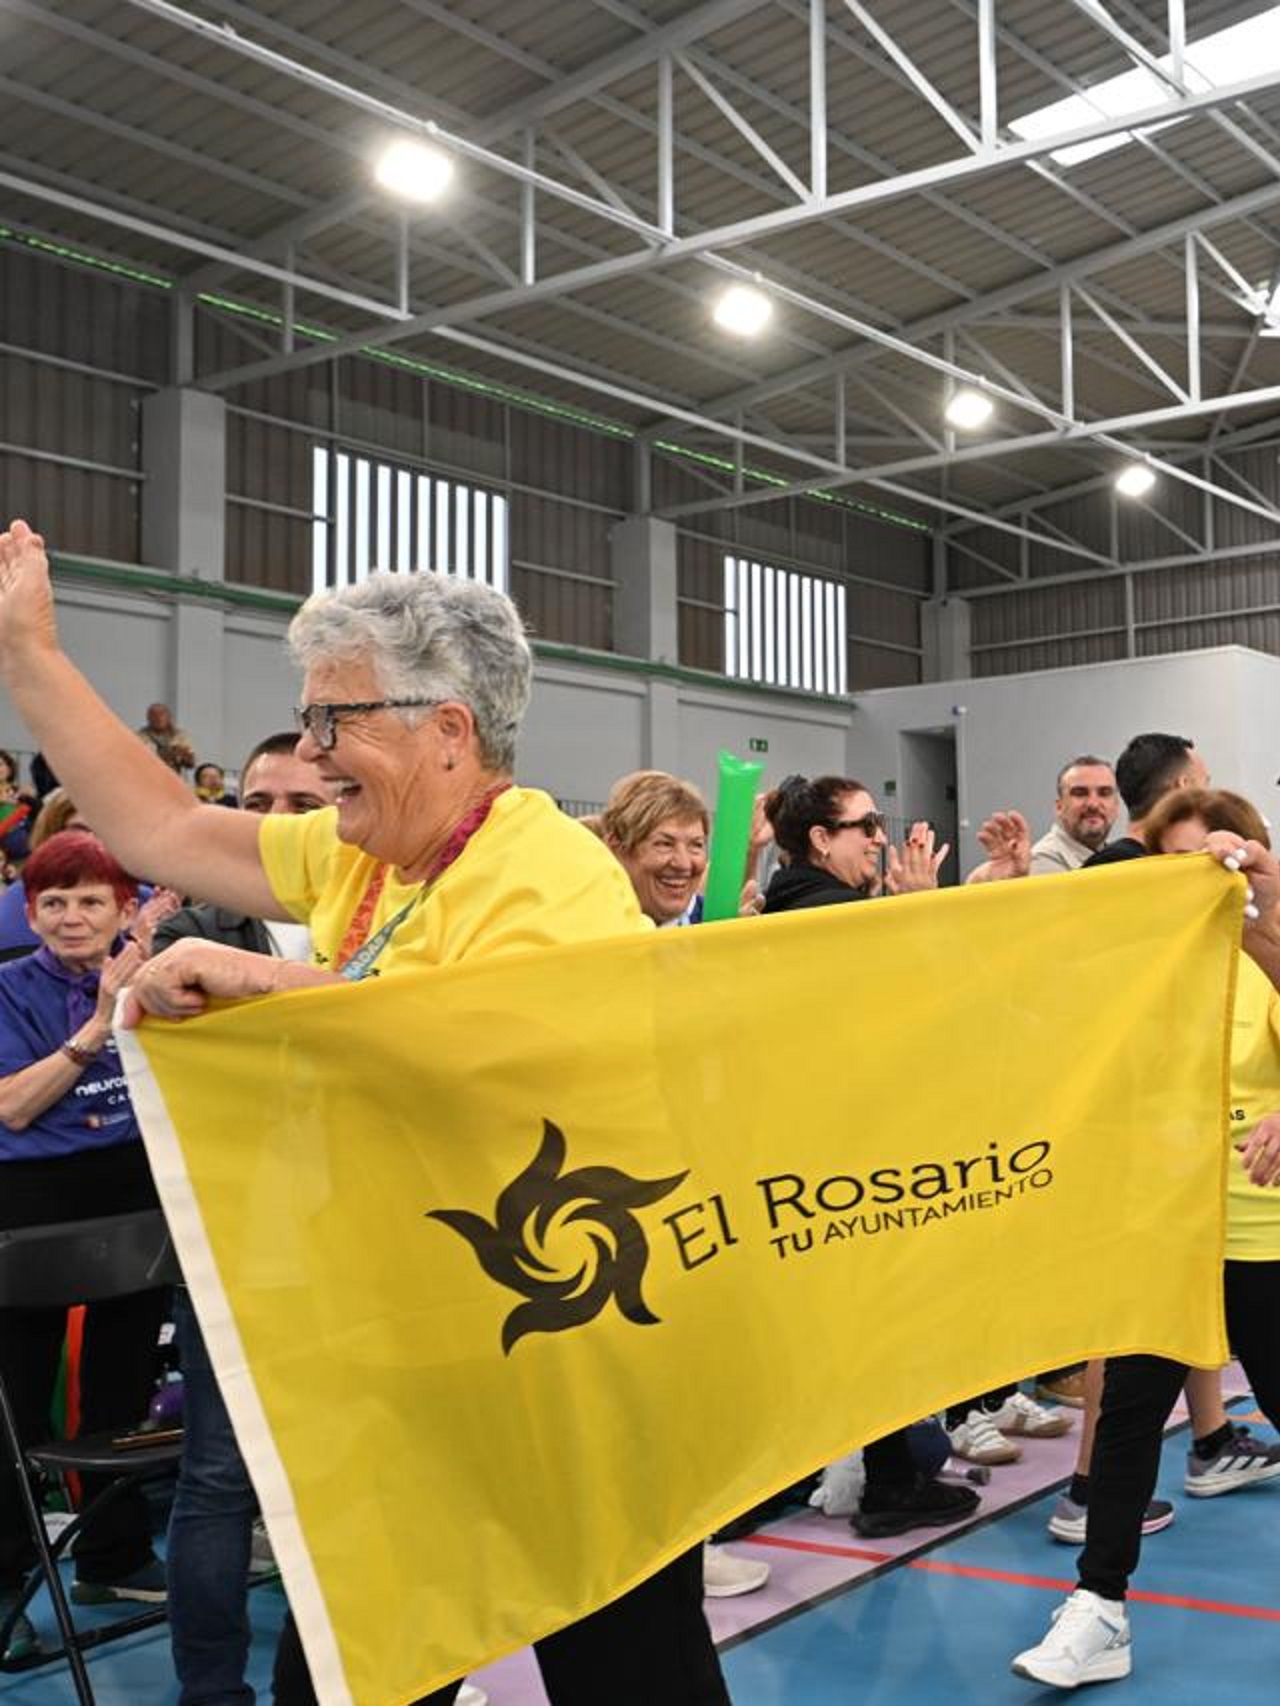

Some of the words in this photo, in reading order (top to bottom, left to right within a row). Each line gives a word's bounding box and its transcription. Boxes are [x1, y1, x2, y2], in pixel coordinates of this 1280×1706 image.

[75, 1076, 128, 1096] neuro
[662, 1194, 738, 1271] El
[756, 1140, 1051, 1229] Rosario
[770, 1228, 813, 1259] TU
[823, 1168, 1053, 1245] AYUNTAMIENTO
